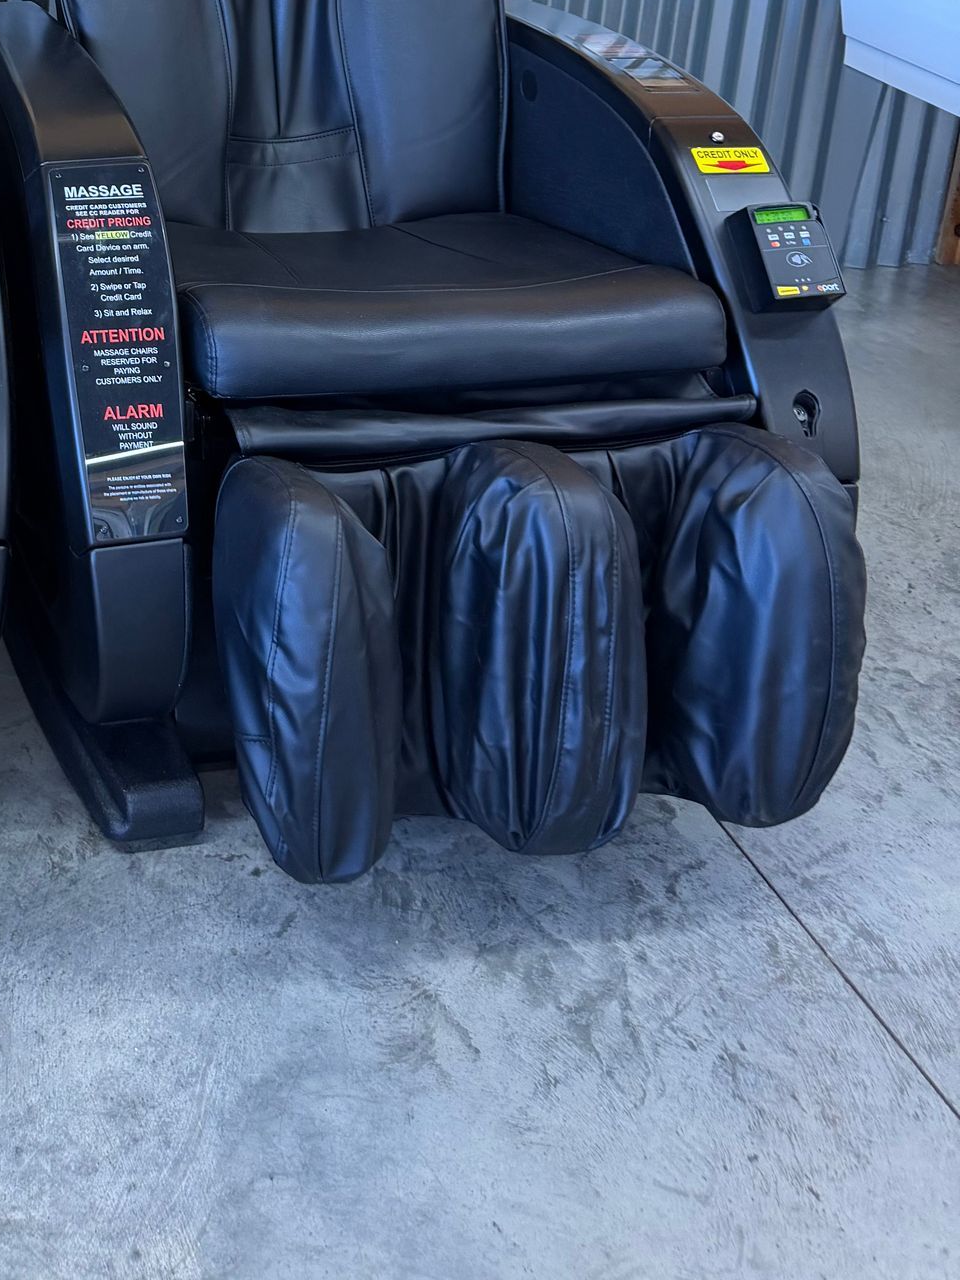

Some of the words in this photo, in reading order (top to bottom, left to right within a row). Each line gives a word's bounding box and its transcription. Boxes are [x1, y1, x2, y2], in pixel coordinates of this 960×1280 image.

[697, 150, 732, 159] CREDIT
[734, 150, 758, 159] ONLY
[64, 184, 143, 198] MASSAGE
[67, 218, 105, 229] CREDIT
[108, 216, 151, 227] PRICING
[71, 234, 79, 242] 1)
[95, 231, 129, 239] YELLOW
[91, 283, 99, 292] 2)
[133, 282, 147, 290] Tap
[94, 310, 102, 318] 3)
[103, 309, 114, 317] Sit
[81, 327, 165, 344] ATTENTION
[94, 348, 129, 357] MASSAGE
[130, 347, 158, 355] CHAIRS
[101, 357, 140, 365] RESERVED
[114, 367, 140, 375] PAYING
[96, 377, 142, 385] CUSTOMERS
[143, 375, 163, 383] ONLY
[103, 403, 163, 420] ALARM
[112, 423, 129, 431] WILL
[131, 422, 157, 430] SOUND
[118, 432, 152, 440] WITHOUT
[119, 441, 154, 449] PAYMENT
